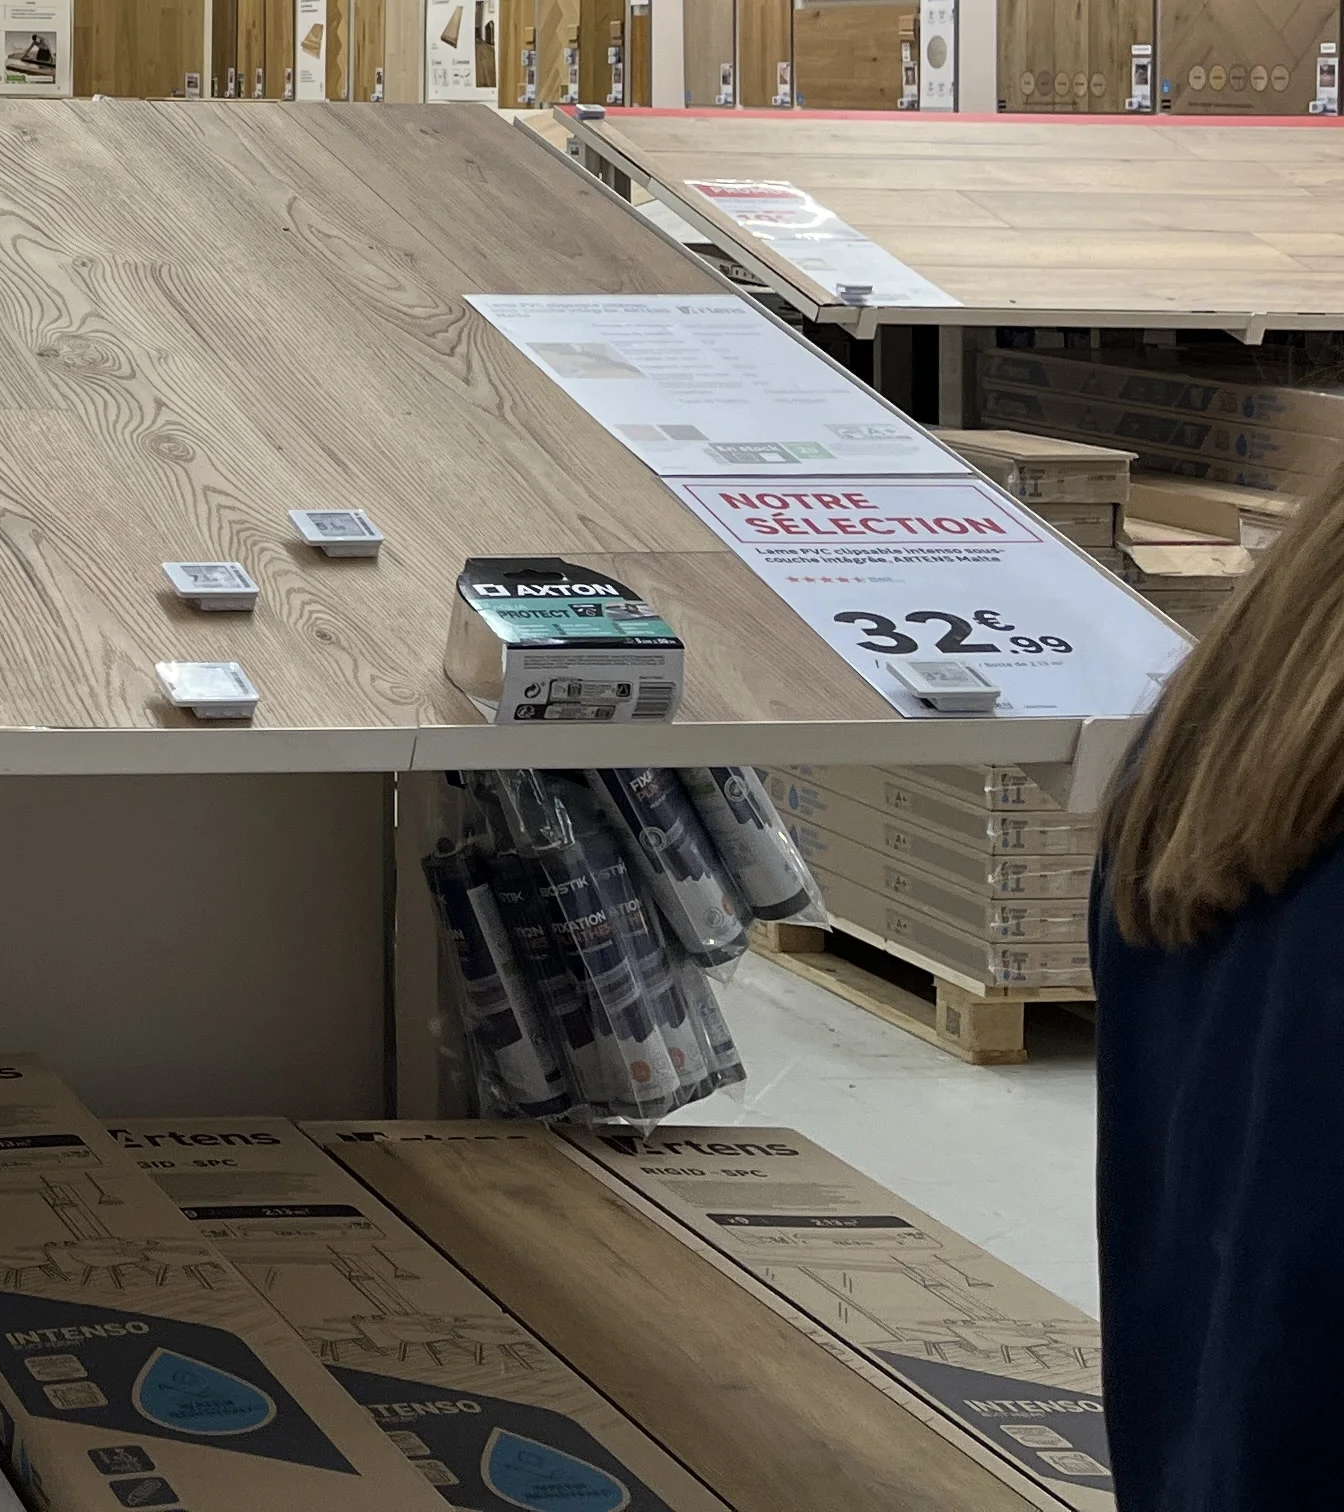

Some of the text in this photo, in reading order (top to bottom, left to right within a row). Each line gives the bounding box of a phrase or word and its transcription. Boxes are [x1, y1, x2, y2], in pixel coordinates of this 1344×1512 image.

[718, 492, 879, 510] NOTRE
[745, 512, 1007, 535] SÉLECTION
[765, 556, 820, 564] couche
[893, 556, 955, 564] ARTENS
[957, 555, 1002, 563] Malte
[800, 547, 830, 555] PVC
[833, 546, 901, 556] clipsable
[904, 547, 960, 555] intenso
[517, 584, 620, 597] AXTON
[496, 609, 572, 619] PROTECT
[539, 877, 589, 898] BOSTIK
[551, 910, 608, 935] FIXATION
[193, 1158, 238, 1168] SPC
[640, 1167, 768, 1178] RIGID SPC
[5, 1320, 152, 1346] INTENSO
[367, 1399, 483, 1418] TENSO
[962, 1399, 1105, 1418] INTENSO
